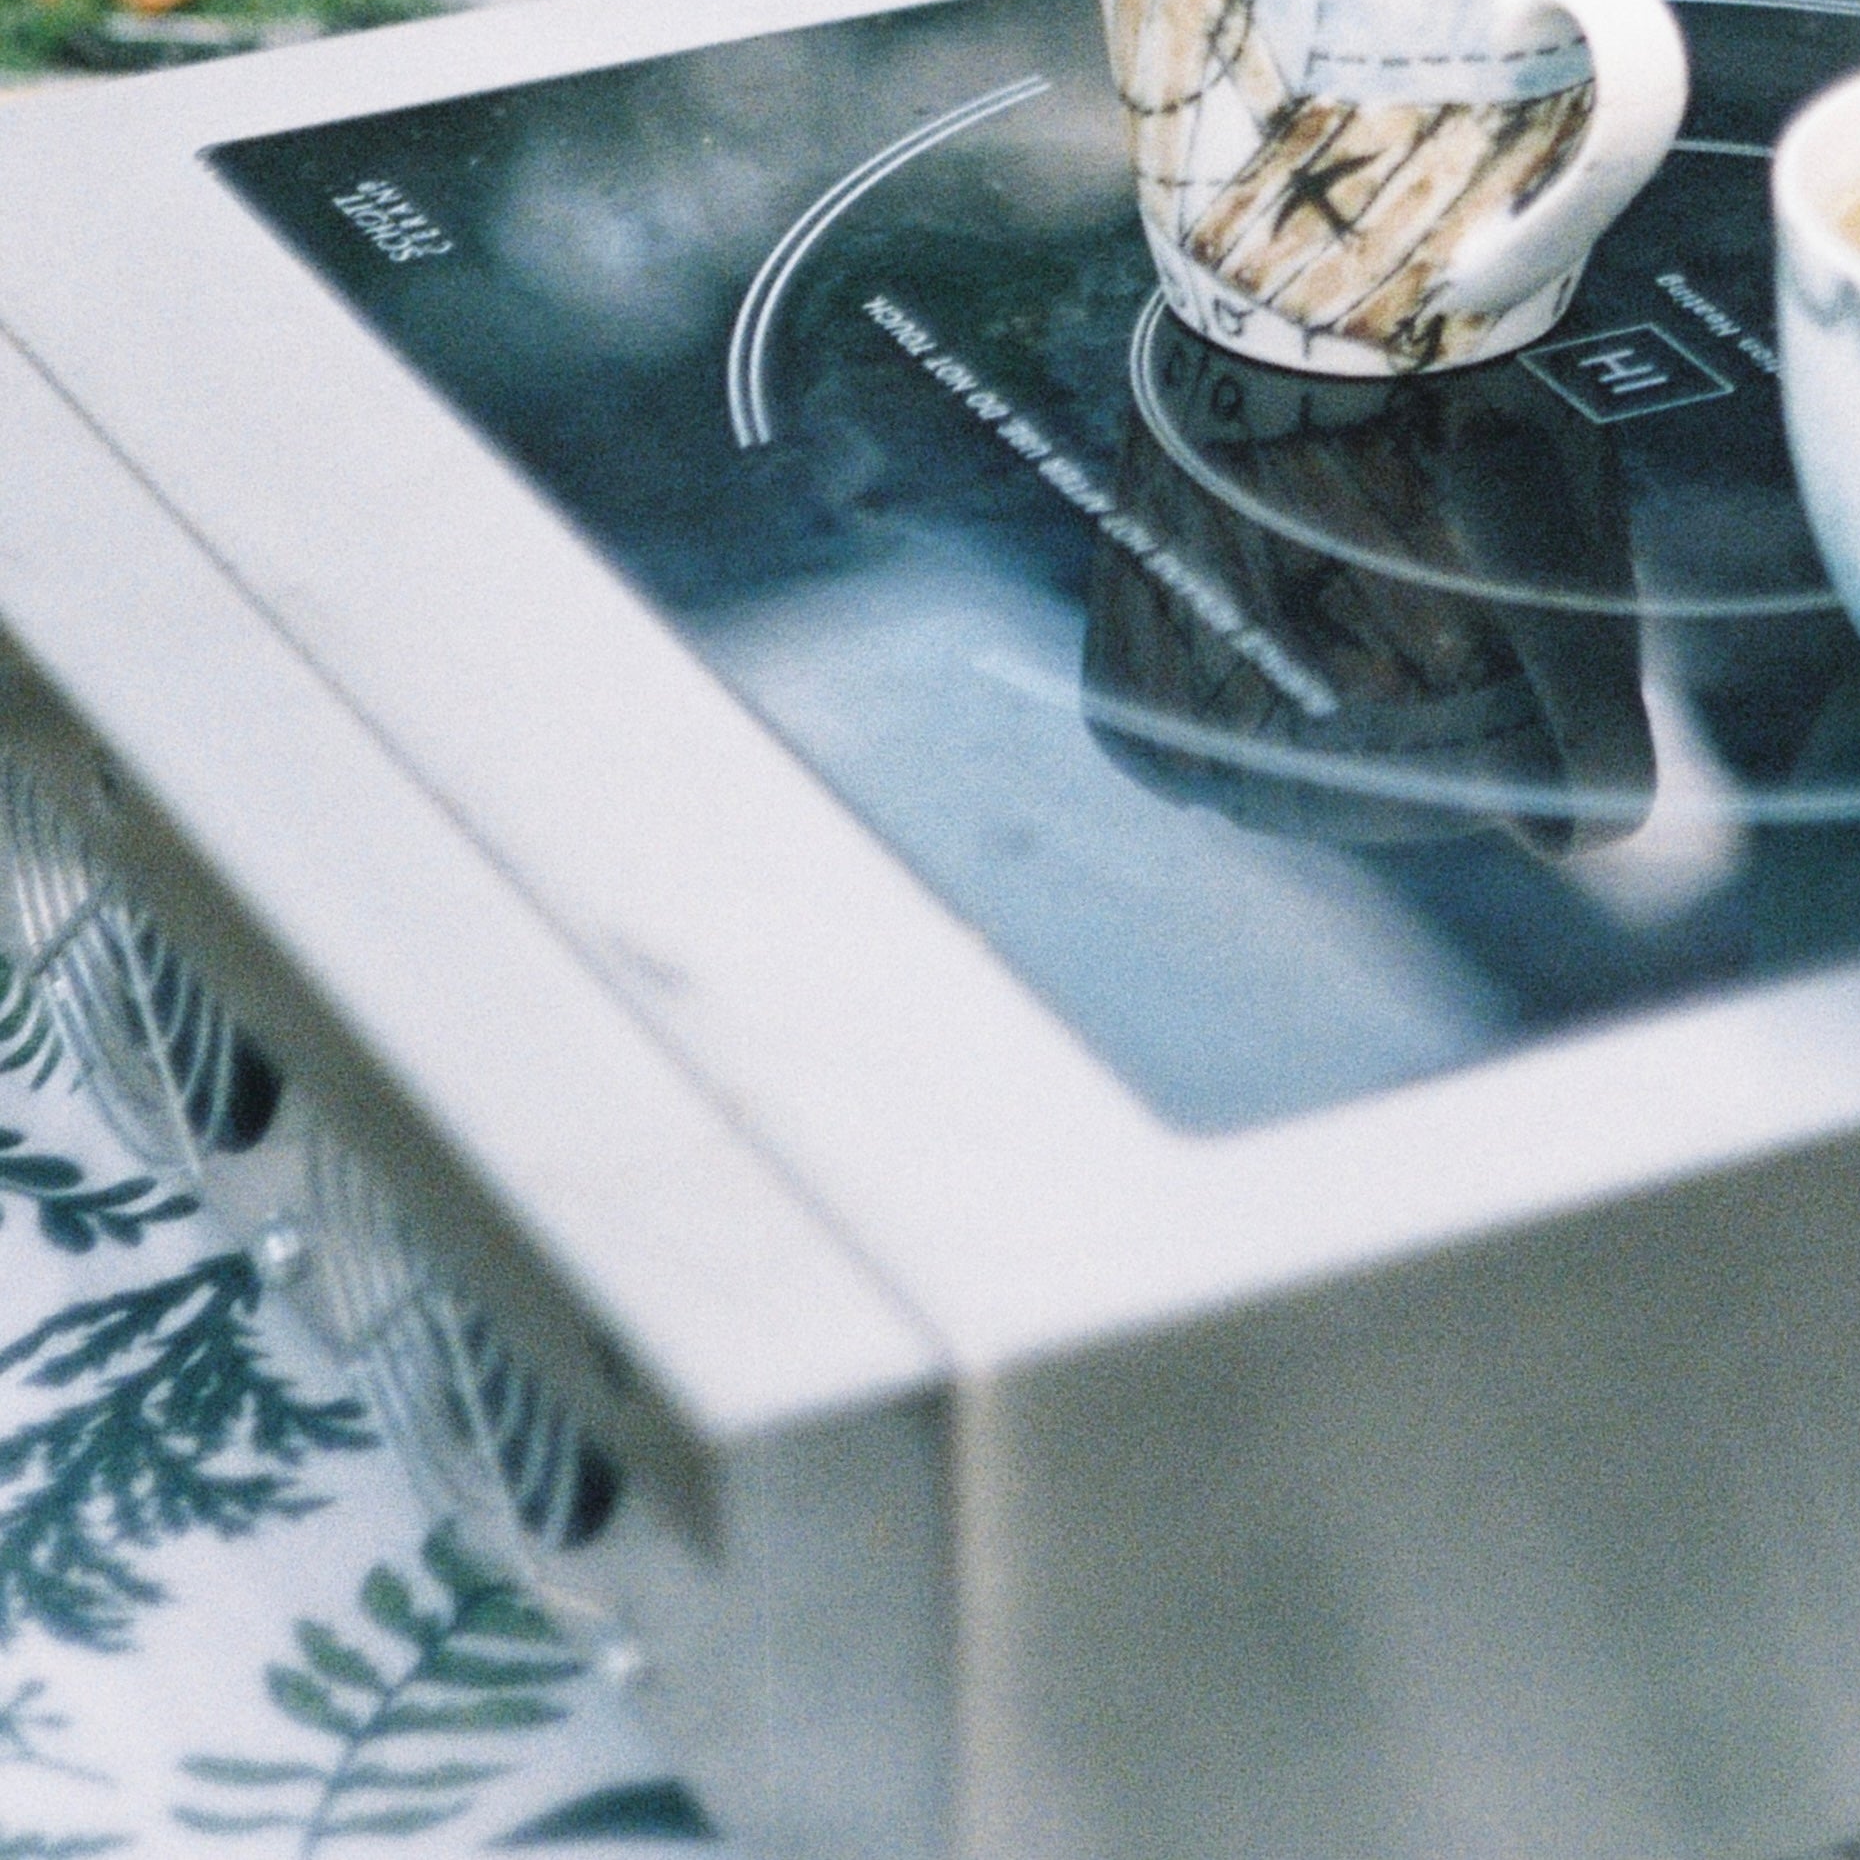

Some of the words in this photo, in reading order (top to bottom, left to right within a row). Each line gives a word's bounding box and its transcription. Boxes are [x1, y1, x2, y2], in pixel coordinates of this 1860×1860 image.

[332, 193, 412, 261] SCHOTT
[922, 355, 979, 392] NOT
[964, 391, 1010, 421] DO
